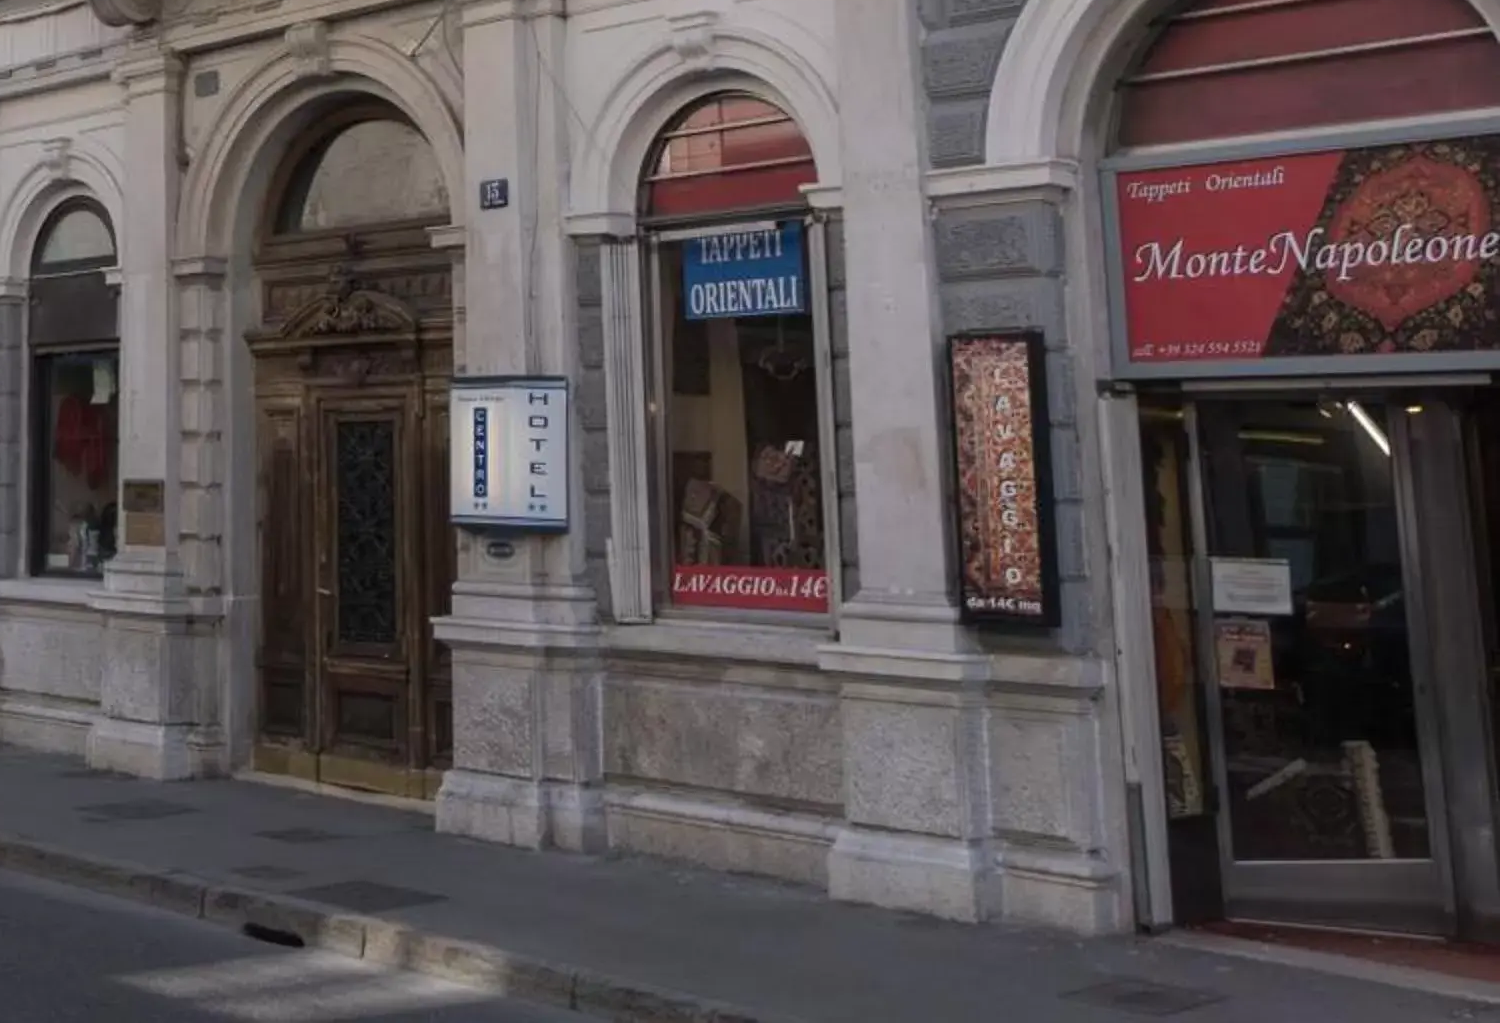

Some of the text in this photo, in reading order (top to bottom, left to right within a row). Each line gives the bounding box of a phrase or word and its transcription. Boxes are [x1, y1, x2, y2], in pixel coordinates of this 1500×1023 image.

[1127, 165, 1285, 203] Tappeti Orientali
[698, 229, 783, 265] TAPPETI
[690, 275, 799, 315] ORIENTALI
[474, 410, 486, 495] CENTRO
[528, 392, 549, 498] HOTEL
[993, 365, 1021, 585] LAVAGGIO
[673, 572, 776, 596] LAVAGGIO
[788, 574, 829, 598] 14€
